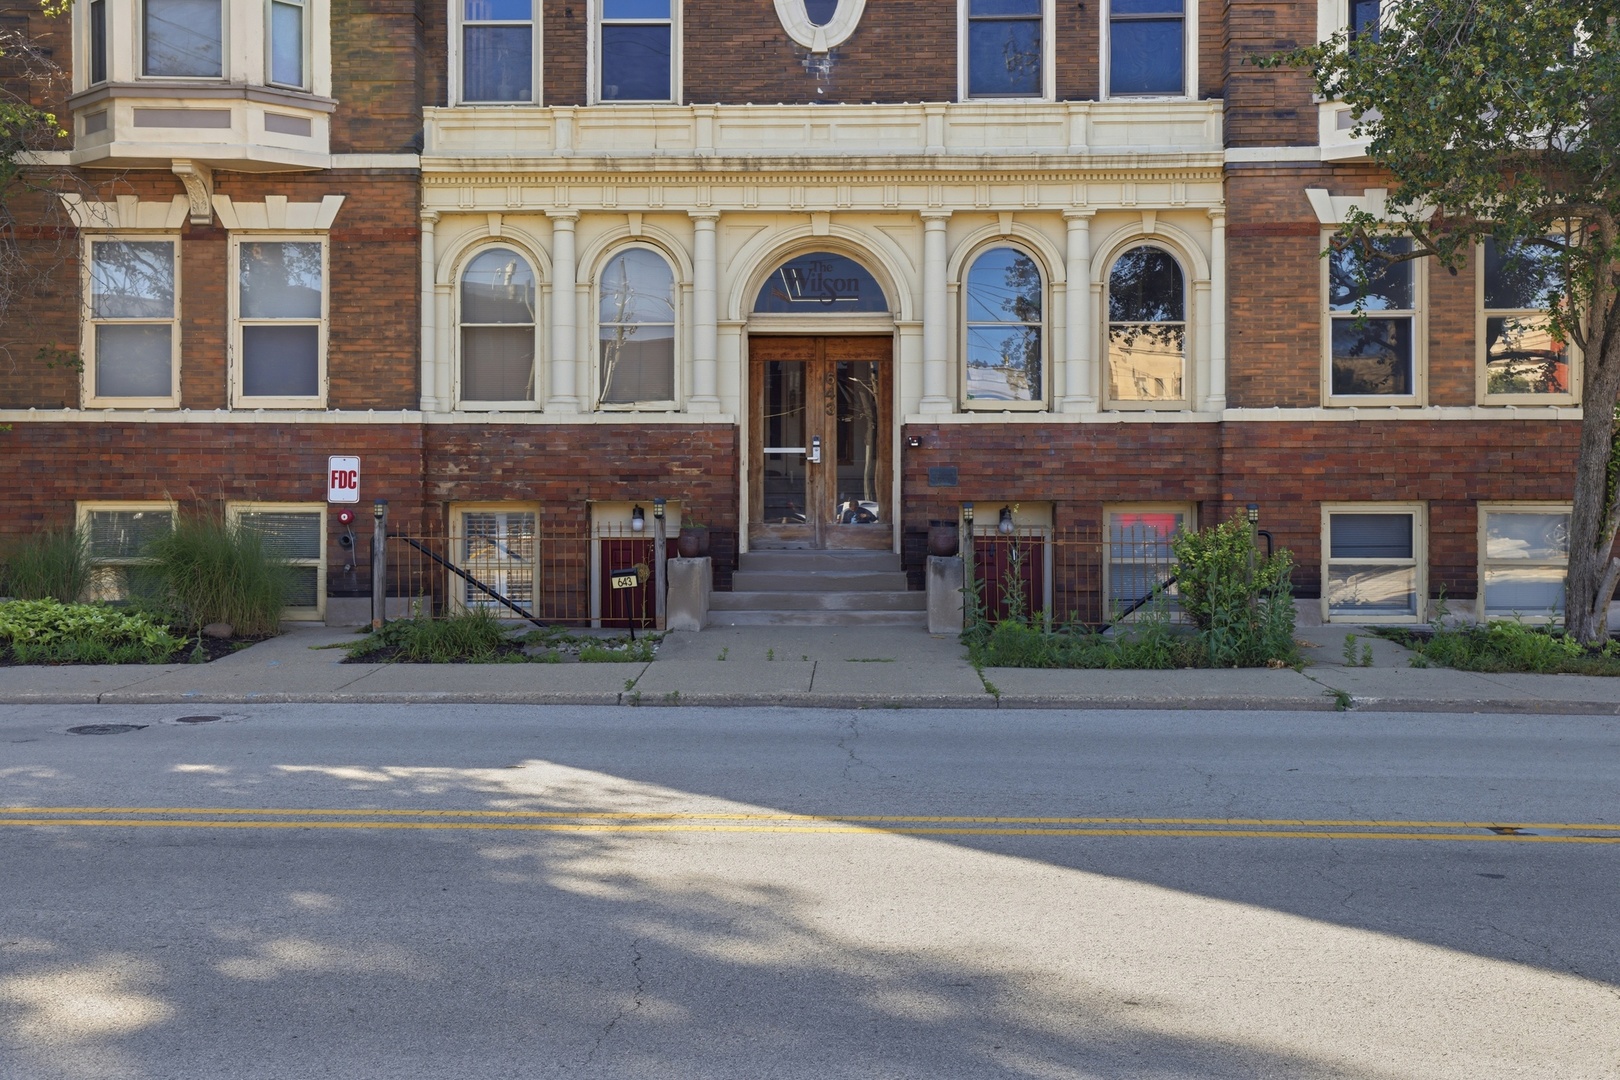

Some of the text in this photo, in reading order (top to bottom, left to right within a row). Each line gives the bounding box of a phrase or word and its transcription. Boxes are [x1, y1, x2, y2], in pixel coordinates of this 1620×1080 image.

[810, 260, 833, 272] The
[780, 267, 859, 306] Wilson
[825, 371, 836, 416] 643
[331, 470, 357, 489] FDC
[617, 576, 633, 587] 643
